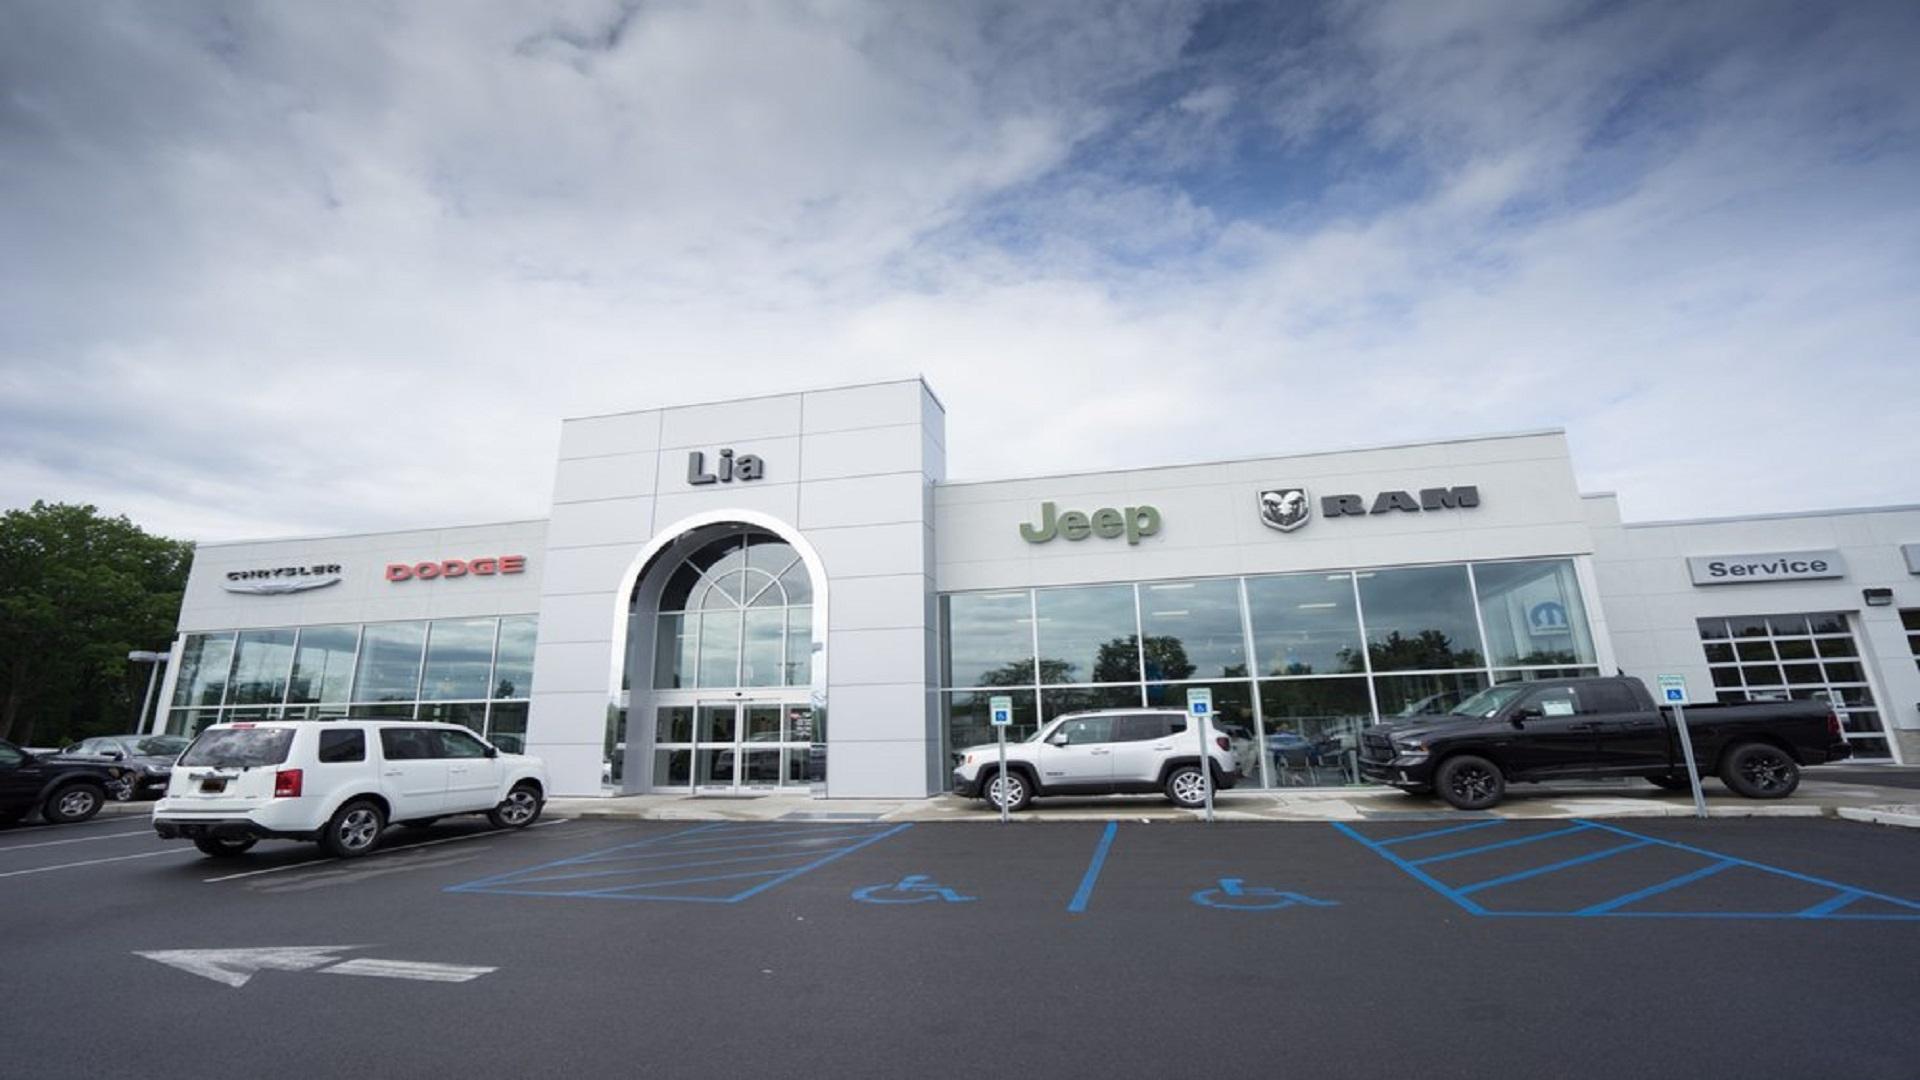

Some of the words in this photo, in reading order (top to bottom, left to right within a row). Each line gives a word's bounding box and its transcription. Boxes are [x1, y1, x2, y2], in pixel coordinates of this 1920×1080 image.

[687, 448, 764, 486] Lia
[1320, 486, 1480, 517] RAM
[1019, 501, 1162, 545] Jeep
[226, 564, 342, 581] CHRYSLER
[385, 555, 527, 582] DODGE
[1707, 558, 1829, 578] Service
